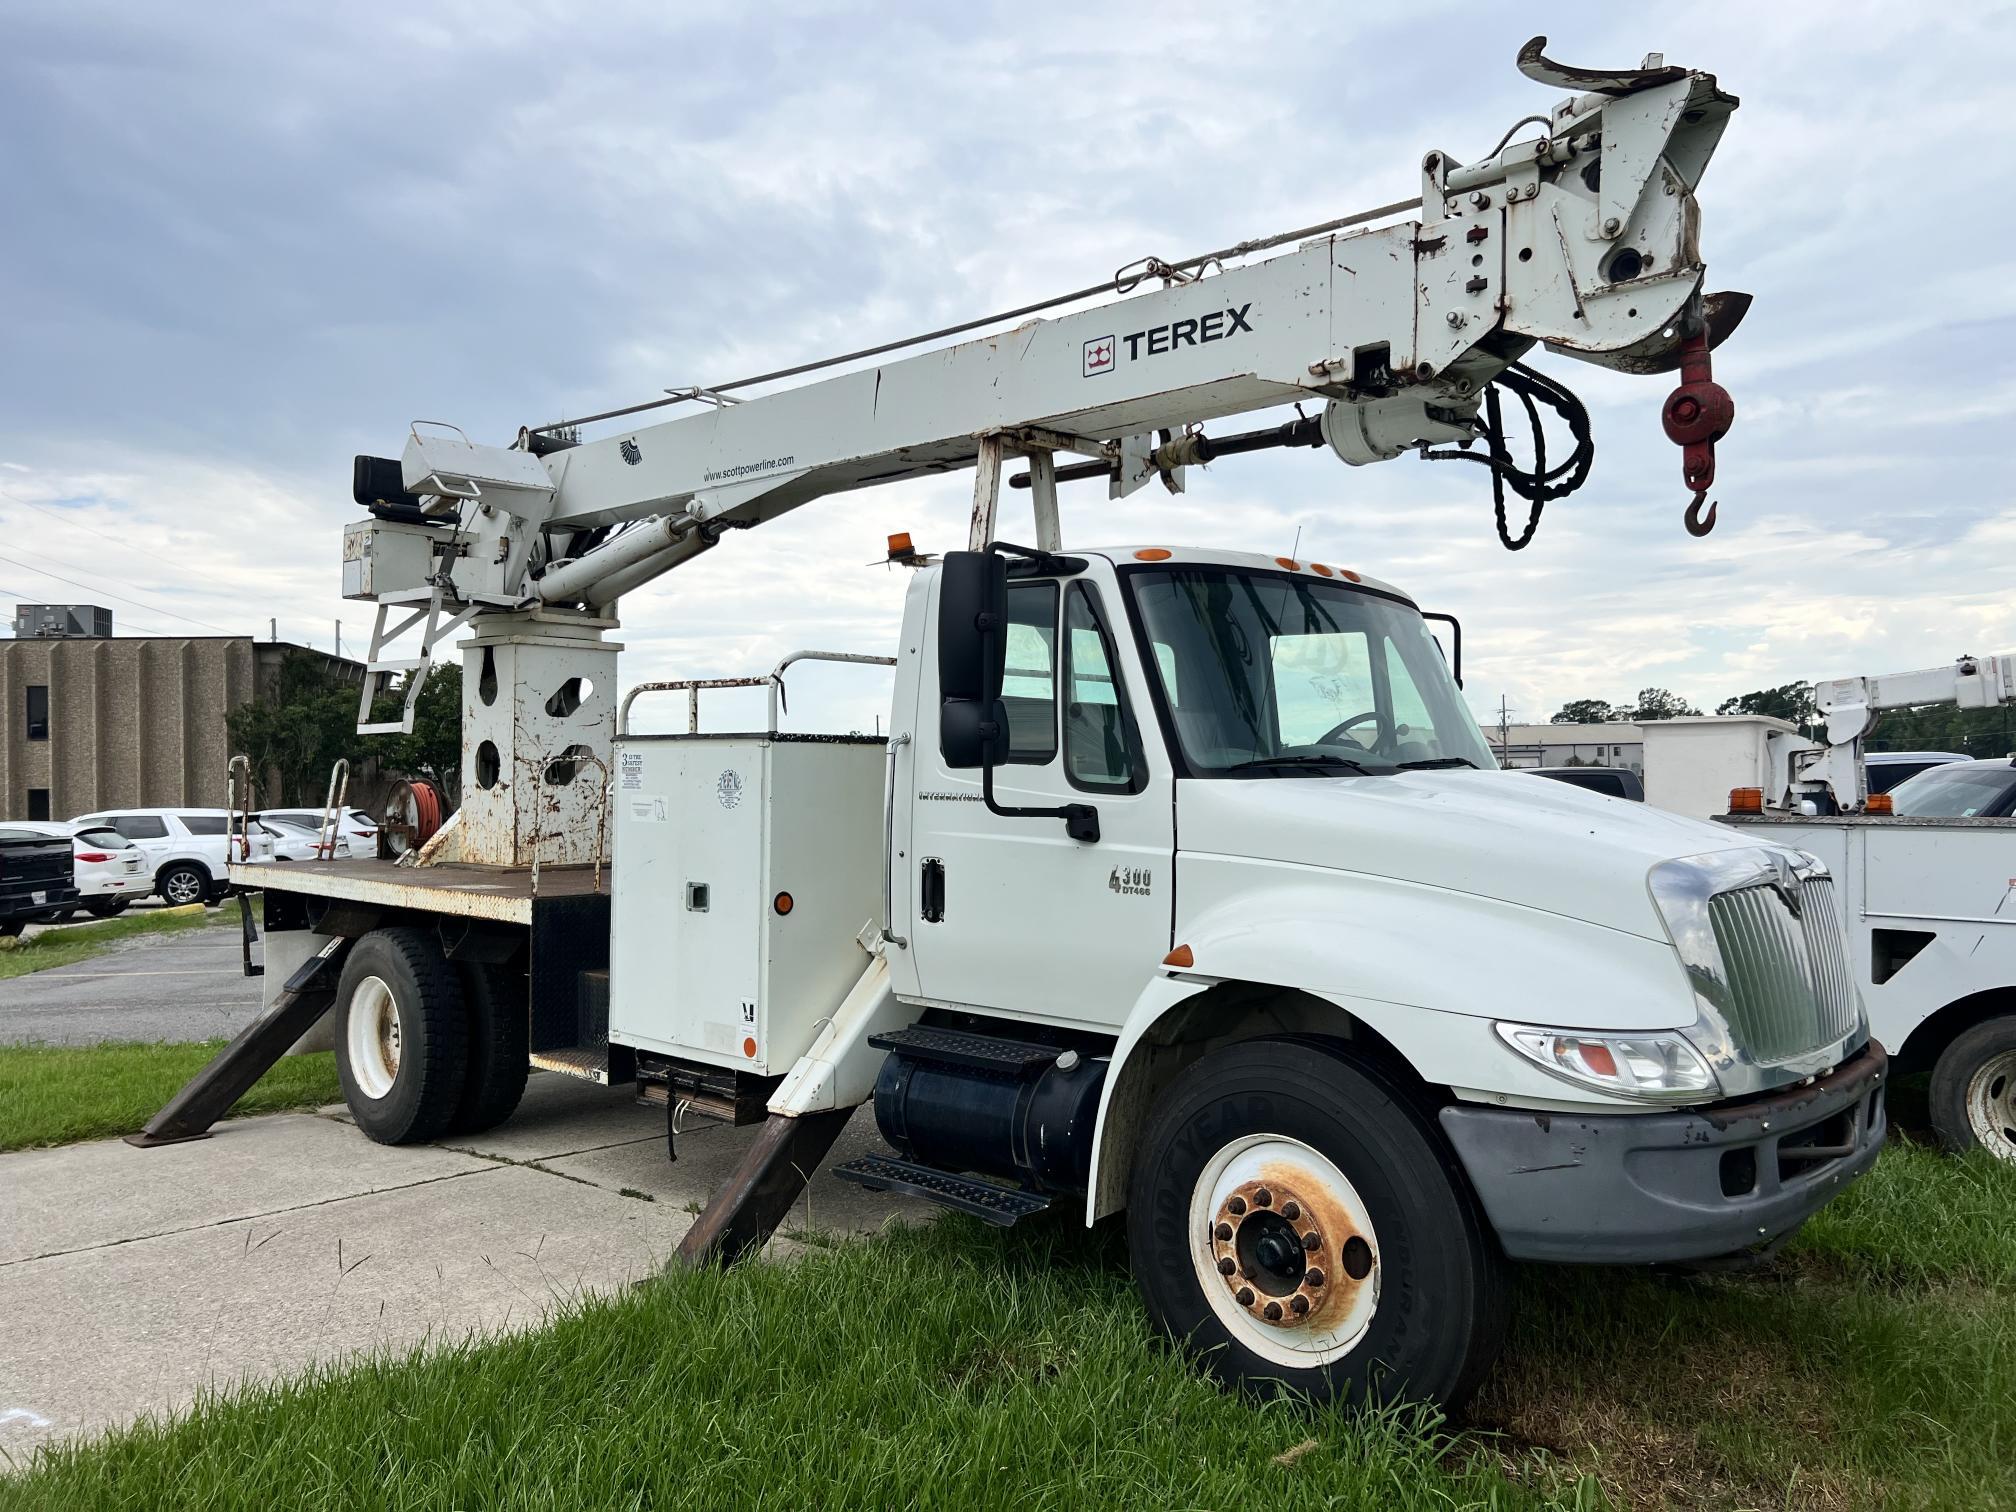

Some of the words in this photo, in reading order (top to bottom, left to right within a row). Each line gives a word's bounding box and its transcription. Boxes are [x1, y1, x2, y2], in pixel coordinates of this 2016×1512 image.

[1123, 303, 1253, 361] TEREX
[703, 455, 794, 482] www.scottpowerline.com
[918, 792, 985, 802] INTERNATIONA
[1109, 865, 1151, 893] 4300
[1122, 886, 1151, 896] DT466
